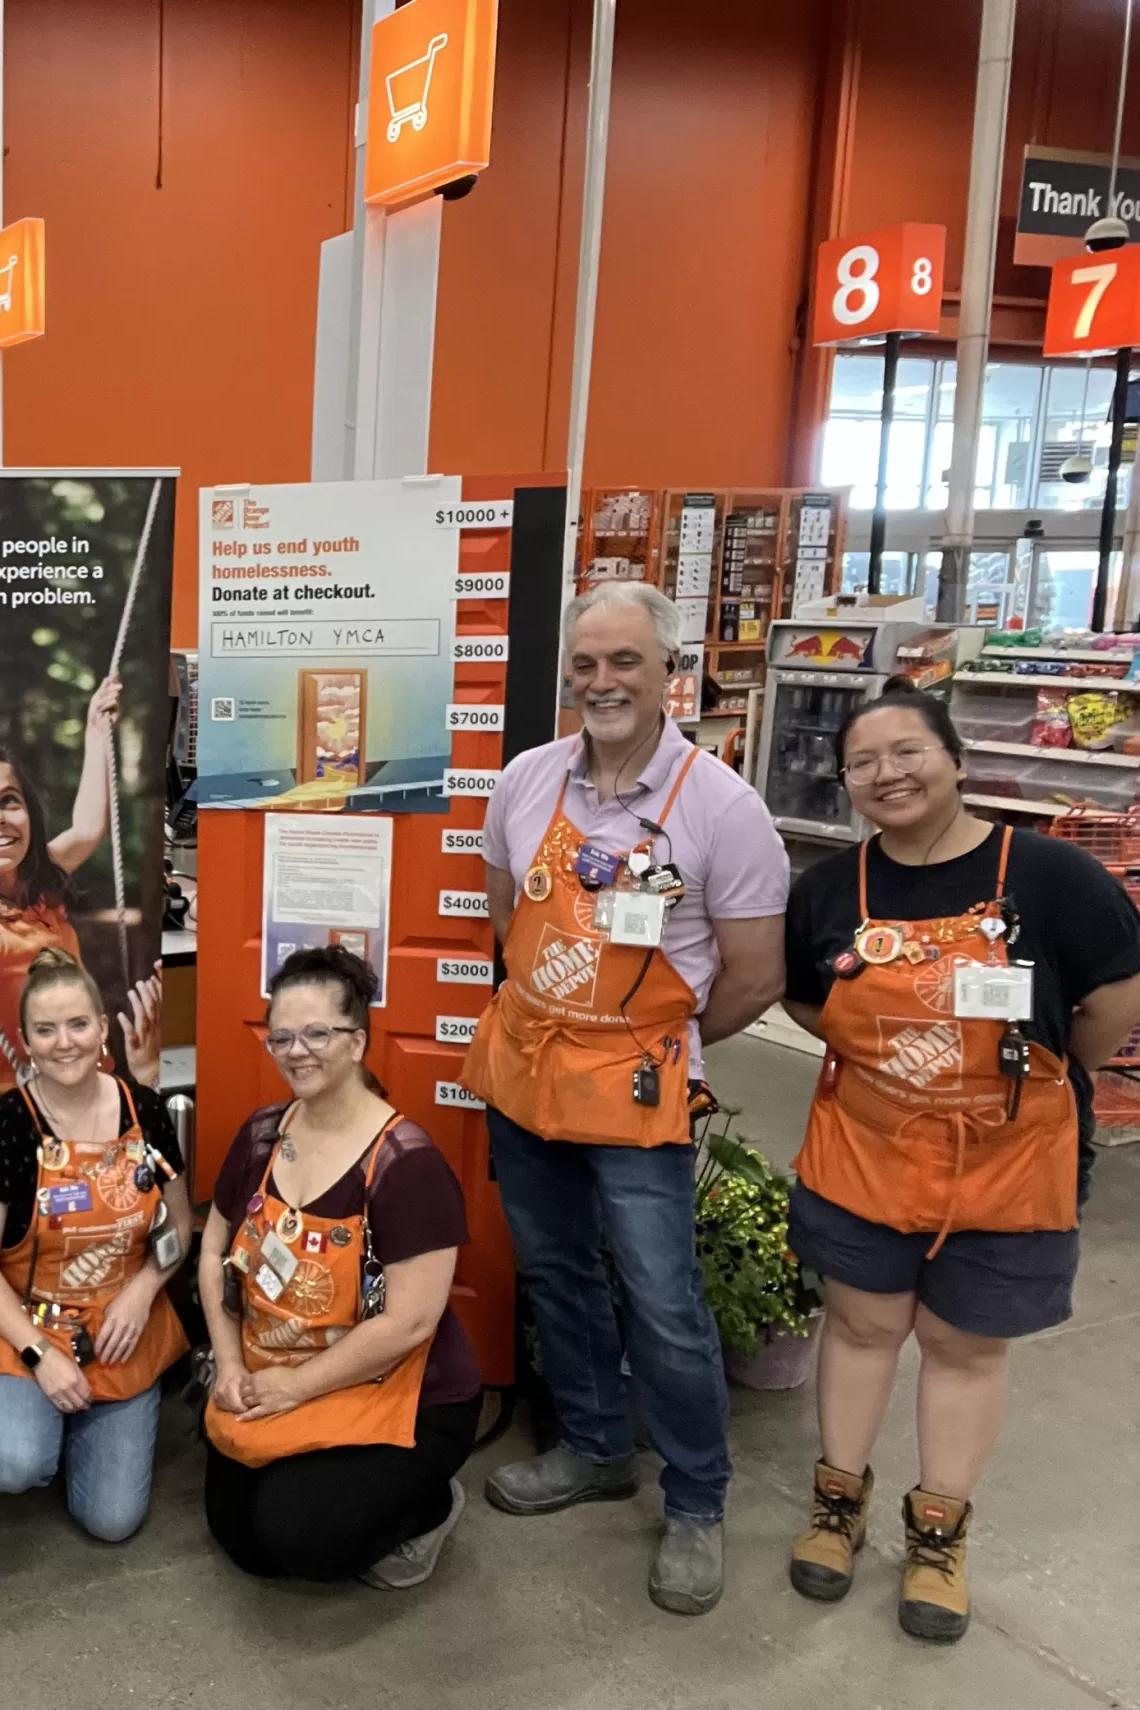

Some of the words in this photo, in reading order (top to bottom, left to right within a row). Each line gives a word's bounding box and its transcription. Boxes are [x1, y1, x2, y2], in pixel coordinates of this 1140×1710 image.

[1028, 181, 1101, 217] Thank
[911, 257, 933, 295] 8
[832, 245, 880, 325] 8
[1071, 263, 1118, 339] 7
[435, 507, 496, 524] $10000
[500, 508, 510, 520] +
[2, 537, 68, 557] people
[72, 536, 89, 553] in
[212, 540, 248, 559] Help
[253, 542, 272, 555] us
[277, 538, 307, 554] end
[313, 537, 360, 556] youth
[92, 567, 104, 579] a
[212, 563, 332, 579] homelessness.
[212, 586, 268, 601] Donate
[273, 585, 290, 600] at
[294, 584, 376, 600] checkout.
[454, 578, 504, 593] $9000
[11, 588, 96, 608] problem.
[222, 629, 313, 649] HAMILTON
[333, 628, 385, 645] YMCA
[454, 643, 504, 659] $8000
[449, 712, 499, 728] $7000
[446, 775, 495, 791] $6000
[441, 963, 489, 977] $3000
[567, 1009, 598, 1022] more
[439, 1086, 484, 1102] $100
